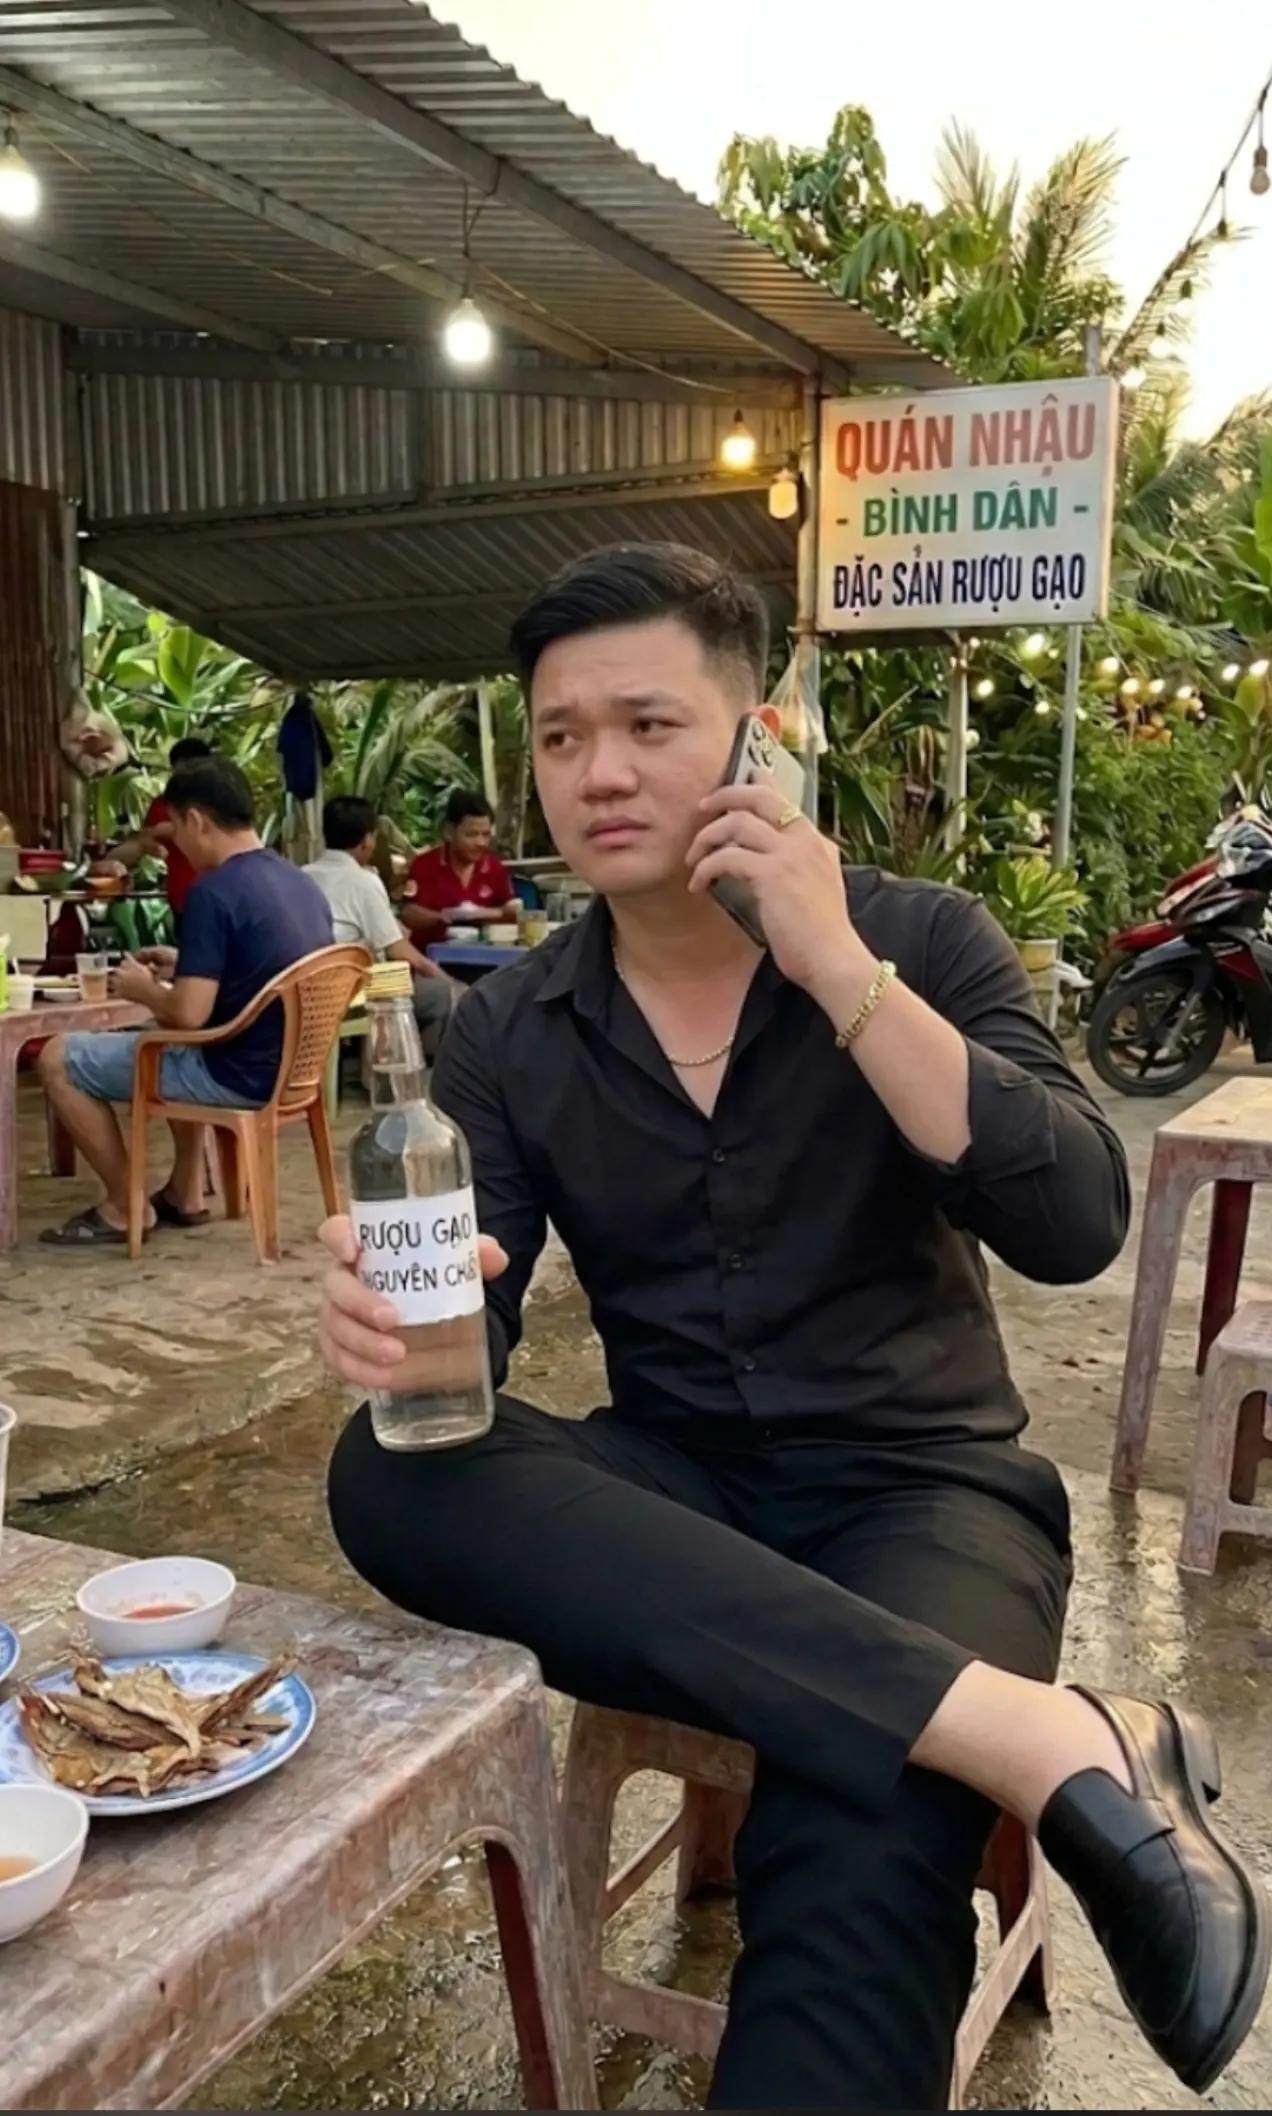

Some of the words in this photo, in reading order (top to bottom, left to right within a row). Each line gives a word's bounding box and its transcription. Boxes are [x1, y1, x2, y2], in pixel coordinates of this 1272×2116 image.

[836, 404, 954, 481] QUÁN
[969, 393, 1096, 477] NHẬU
[864, 487, 958, 537] BÌNH
[973, 480, 1058, 531] DÂN
[833, 554, 883, 617] ĐẶC
[892, 544, 943, 606] SẢN
[952, 554, 1022, 613] RƯỢU
[1032, 553, 1086, 610] GẠO
[360, 1220, 421, 1256] RƯỢU
